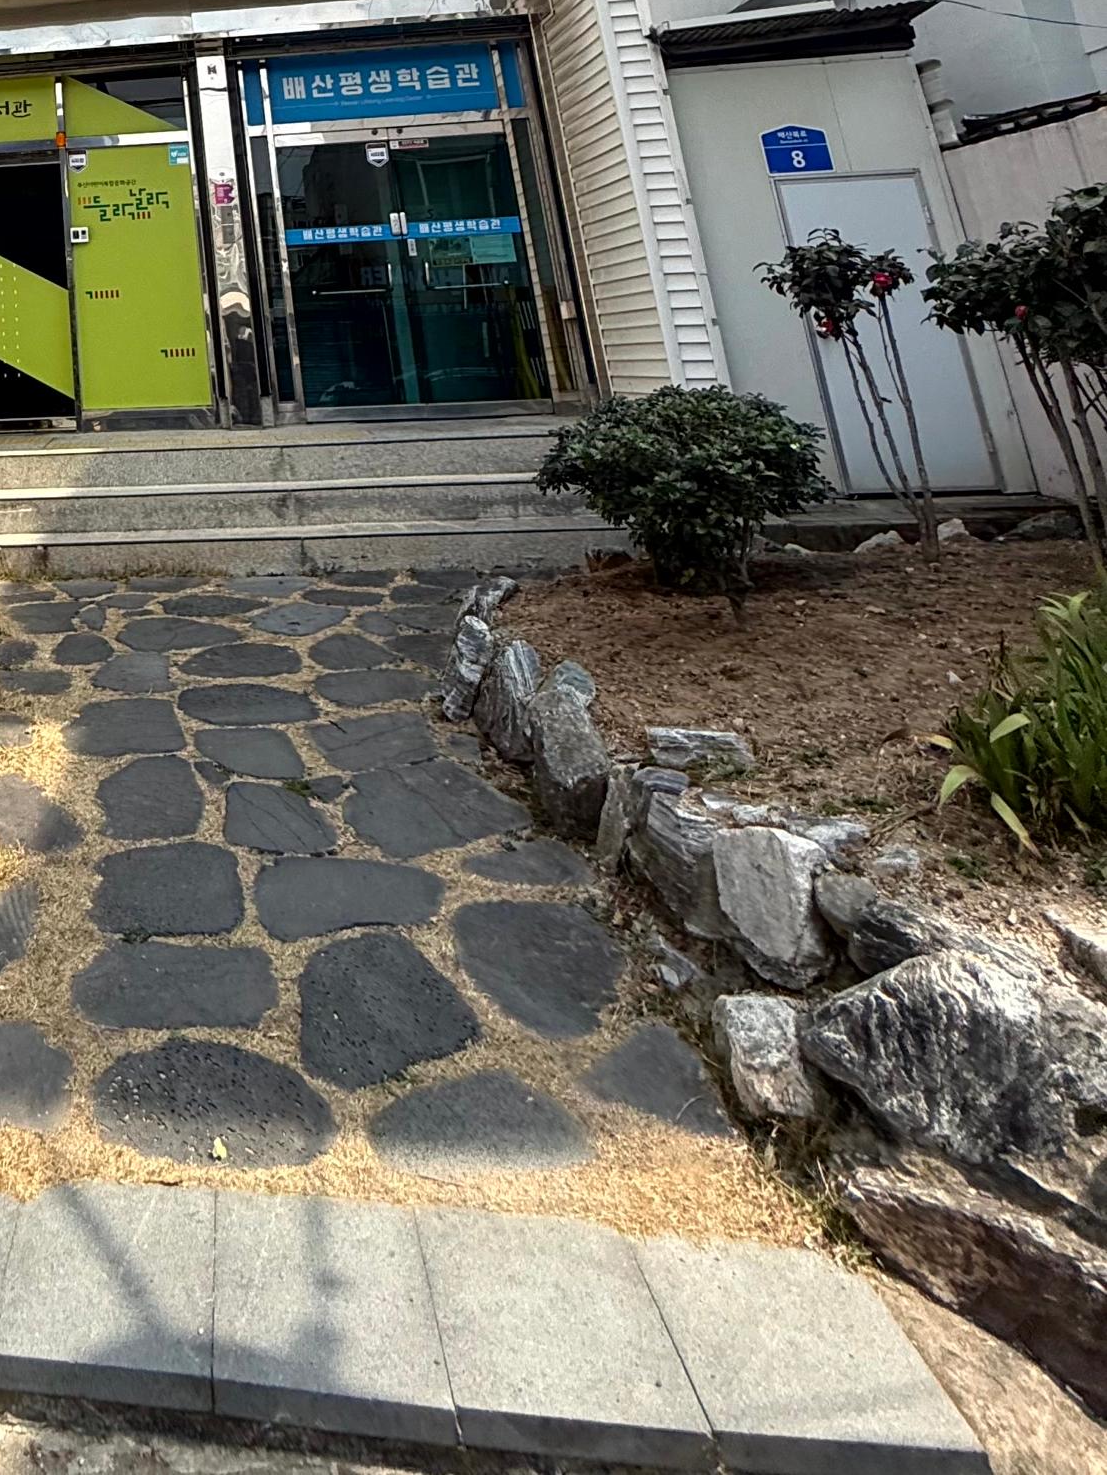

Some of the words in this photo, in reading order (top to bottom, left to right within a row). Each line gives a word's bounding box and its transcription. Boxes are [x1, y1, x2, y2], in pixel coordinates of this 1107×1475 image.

[282, 63, 481, 101] 배산평생학습관
[791, 150, 806, 168] 8
[302, 225, 384, 242] 배산평생학습관
[419, 219, 502, 235] 배산평생학습관
